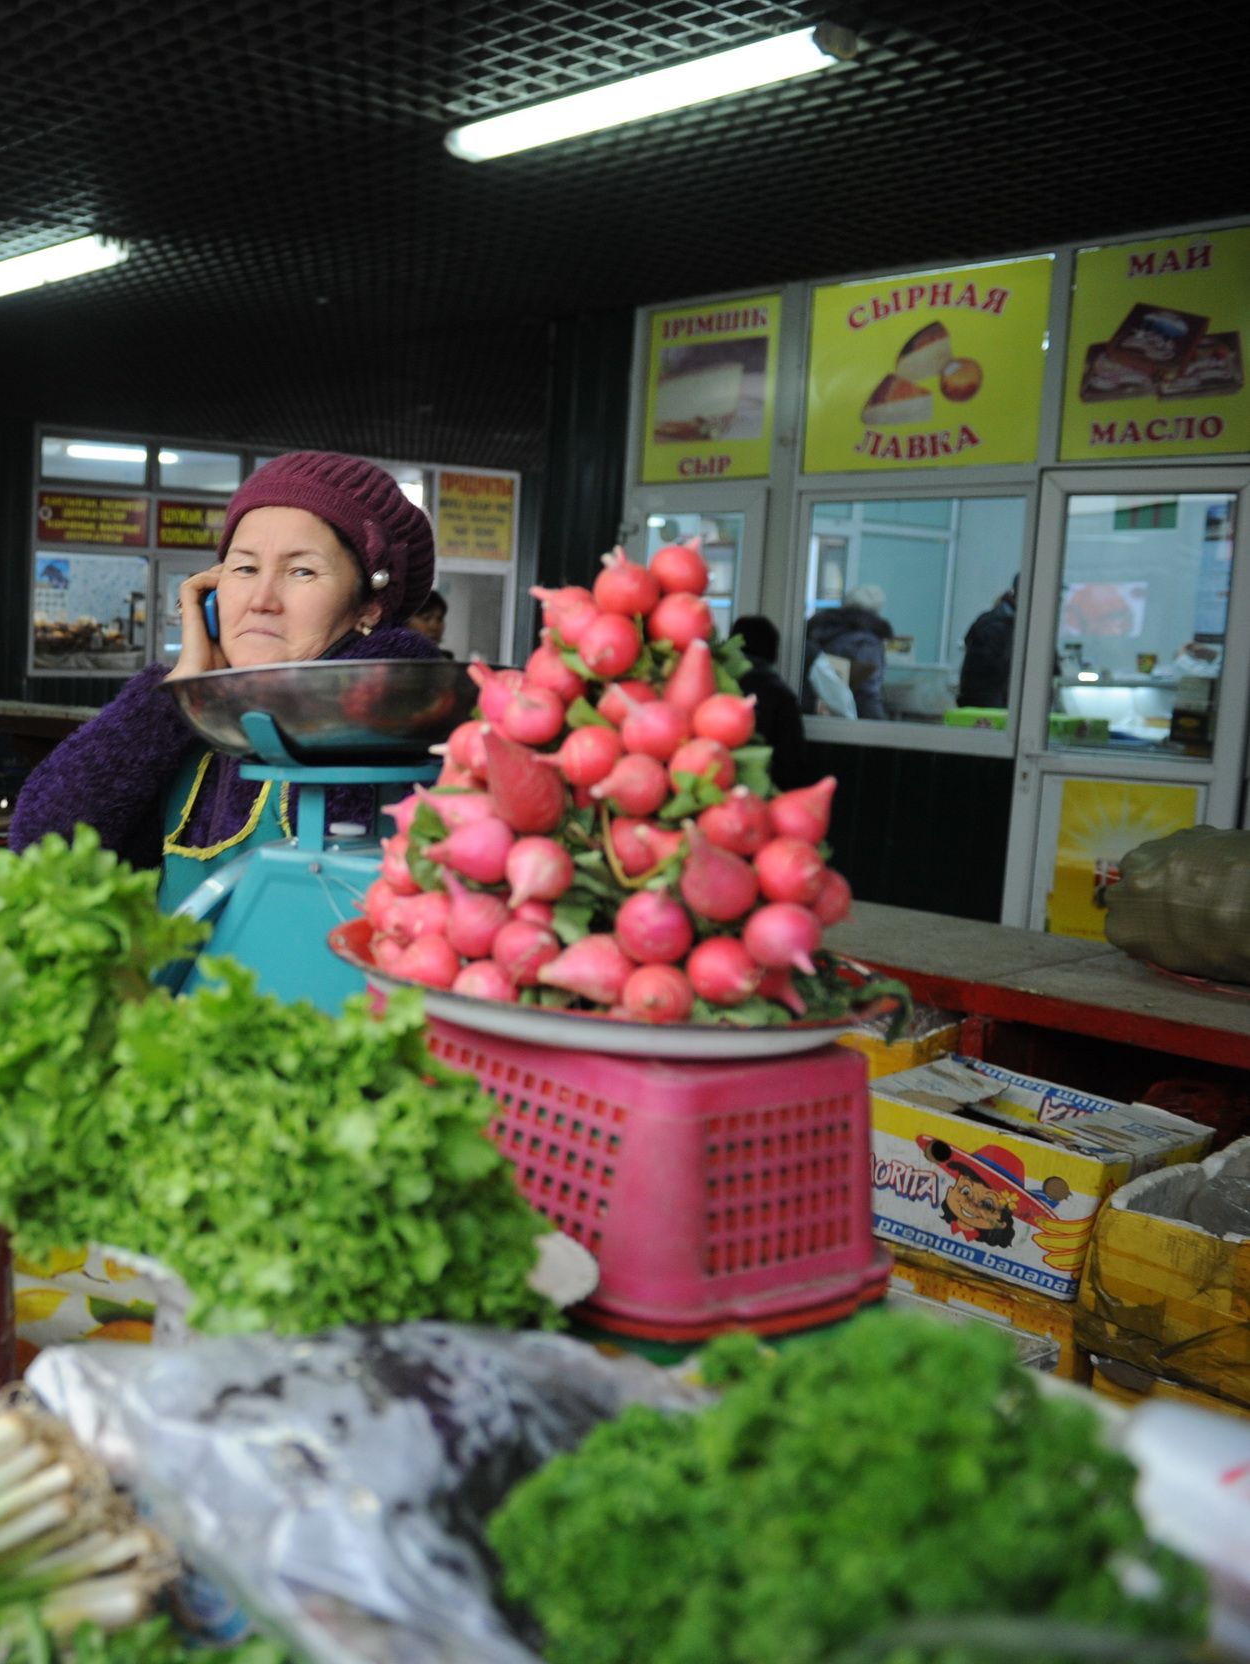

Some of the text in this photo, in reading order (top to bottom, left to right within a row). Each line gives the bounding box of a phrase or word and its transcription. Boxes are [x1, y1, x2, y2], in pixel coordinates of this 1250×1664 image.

[1126, 237, 1214, 278] МАЙ
[847, 281, 1010, 331] СЫРНАЯ
[855, 424, 981, 461] ЛАВКА
[1088, 414, 1226, 447] МАСЛО
[676, 454, 733, 478] СЫР
[878, 1218, 1077, 1294] premium bananas
